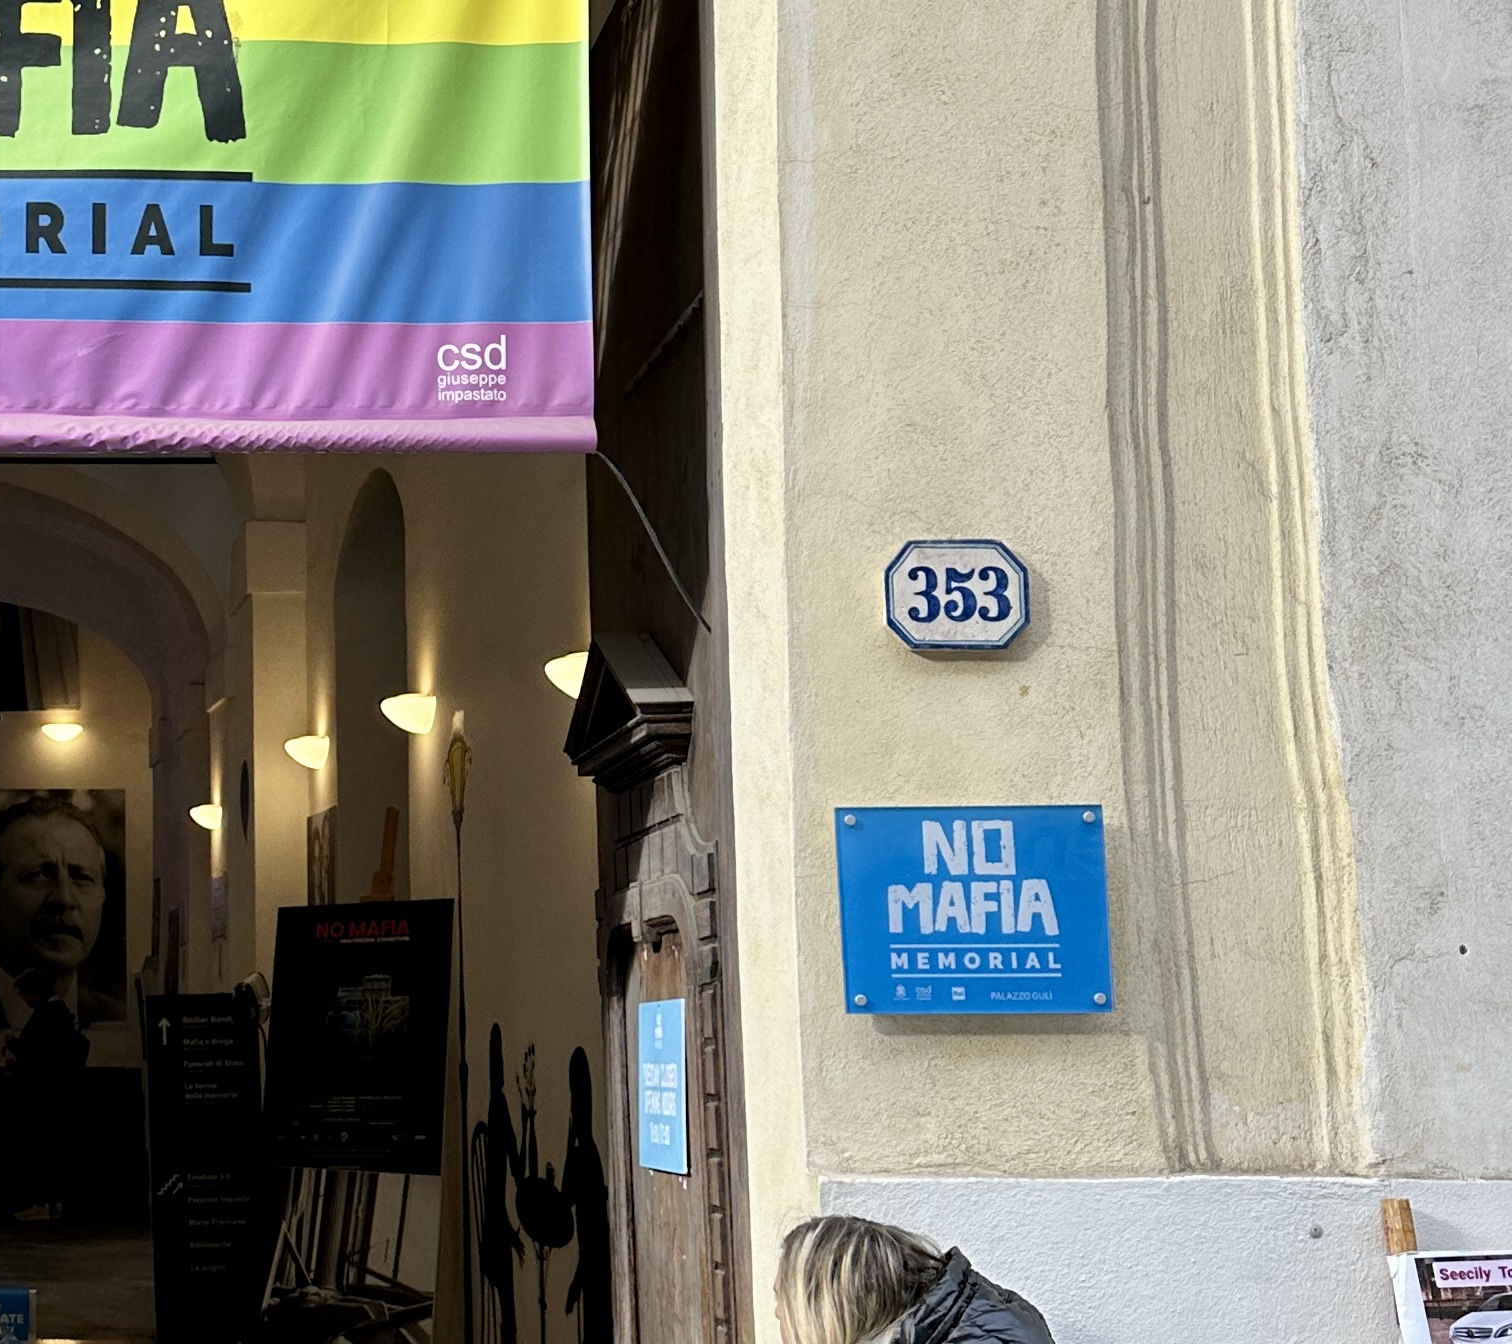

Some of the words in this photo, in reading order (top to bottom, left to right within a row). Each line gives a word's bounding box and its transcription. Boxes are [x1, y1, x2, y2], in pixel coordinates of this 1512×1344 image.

[437, 334, 507, 371] csd
[437, 372, 507, 388] giuseppe
[438, 388, 507, 404] impastato
[907, 565, 1013, 623] 353
[922, 819, 1016, 876] NO
[888, 878, 1060, 936] MAFIA
[316, 922, 345, 939] NO
[349, 920, 409, 936] MAFIA
[890, 951, 1062, 970] MEMORIAL
[990, 991, 1030, 1001] PALAZZO
[1439, 1265, 1492, 1283] Seecily
